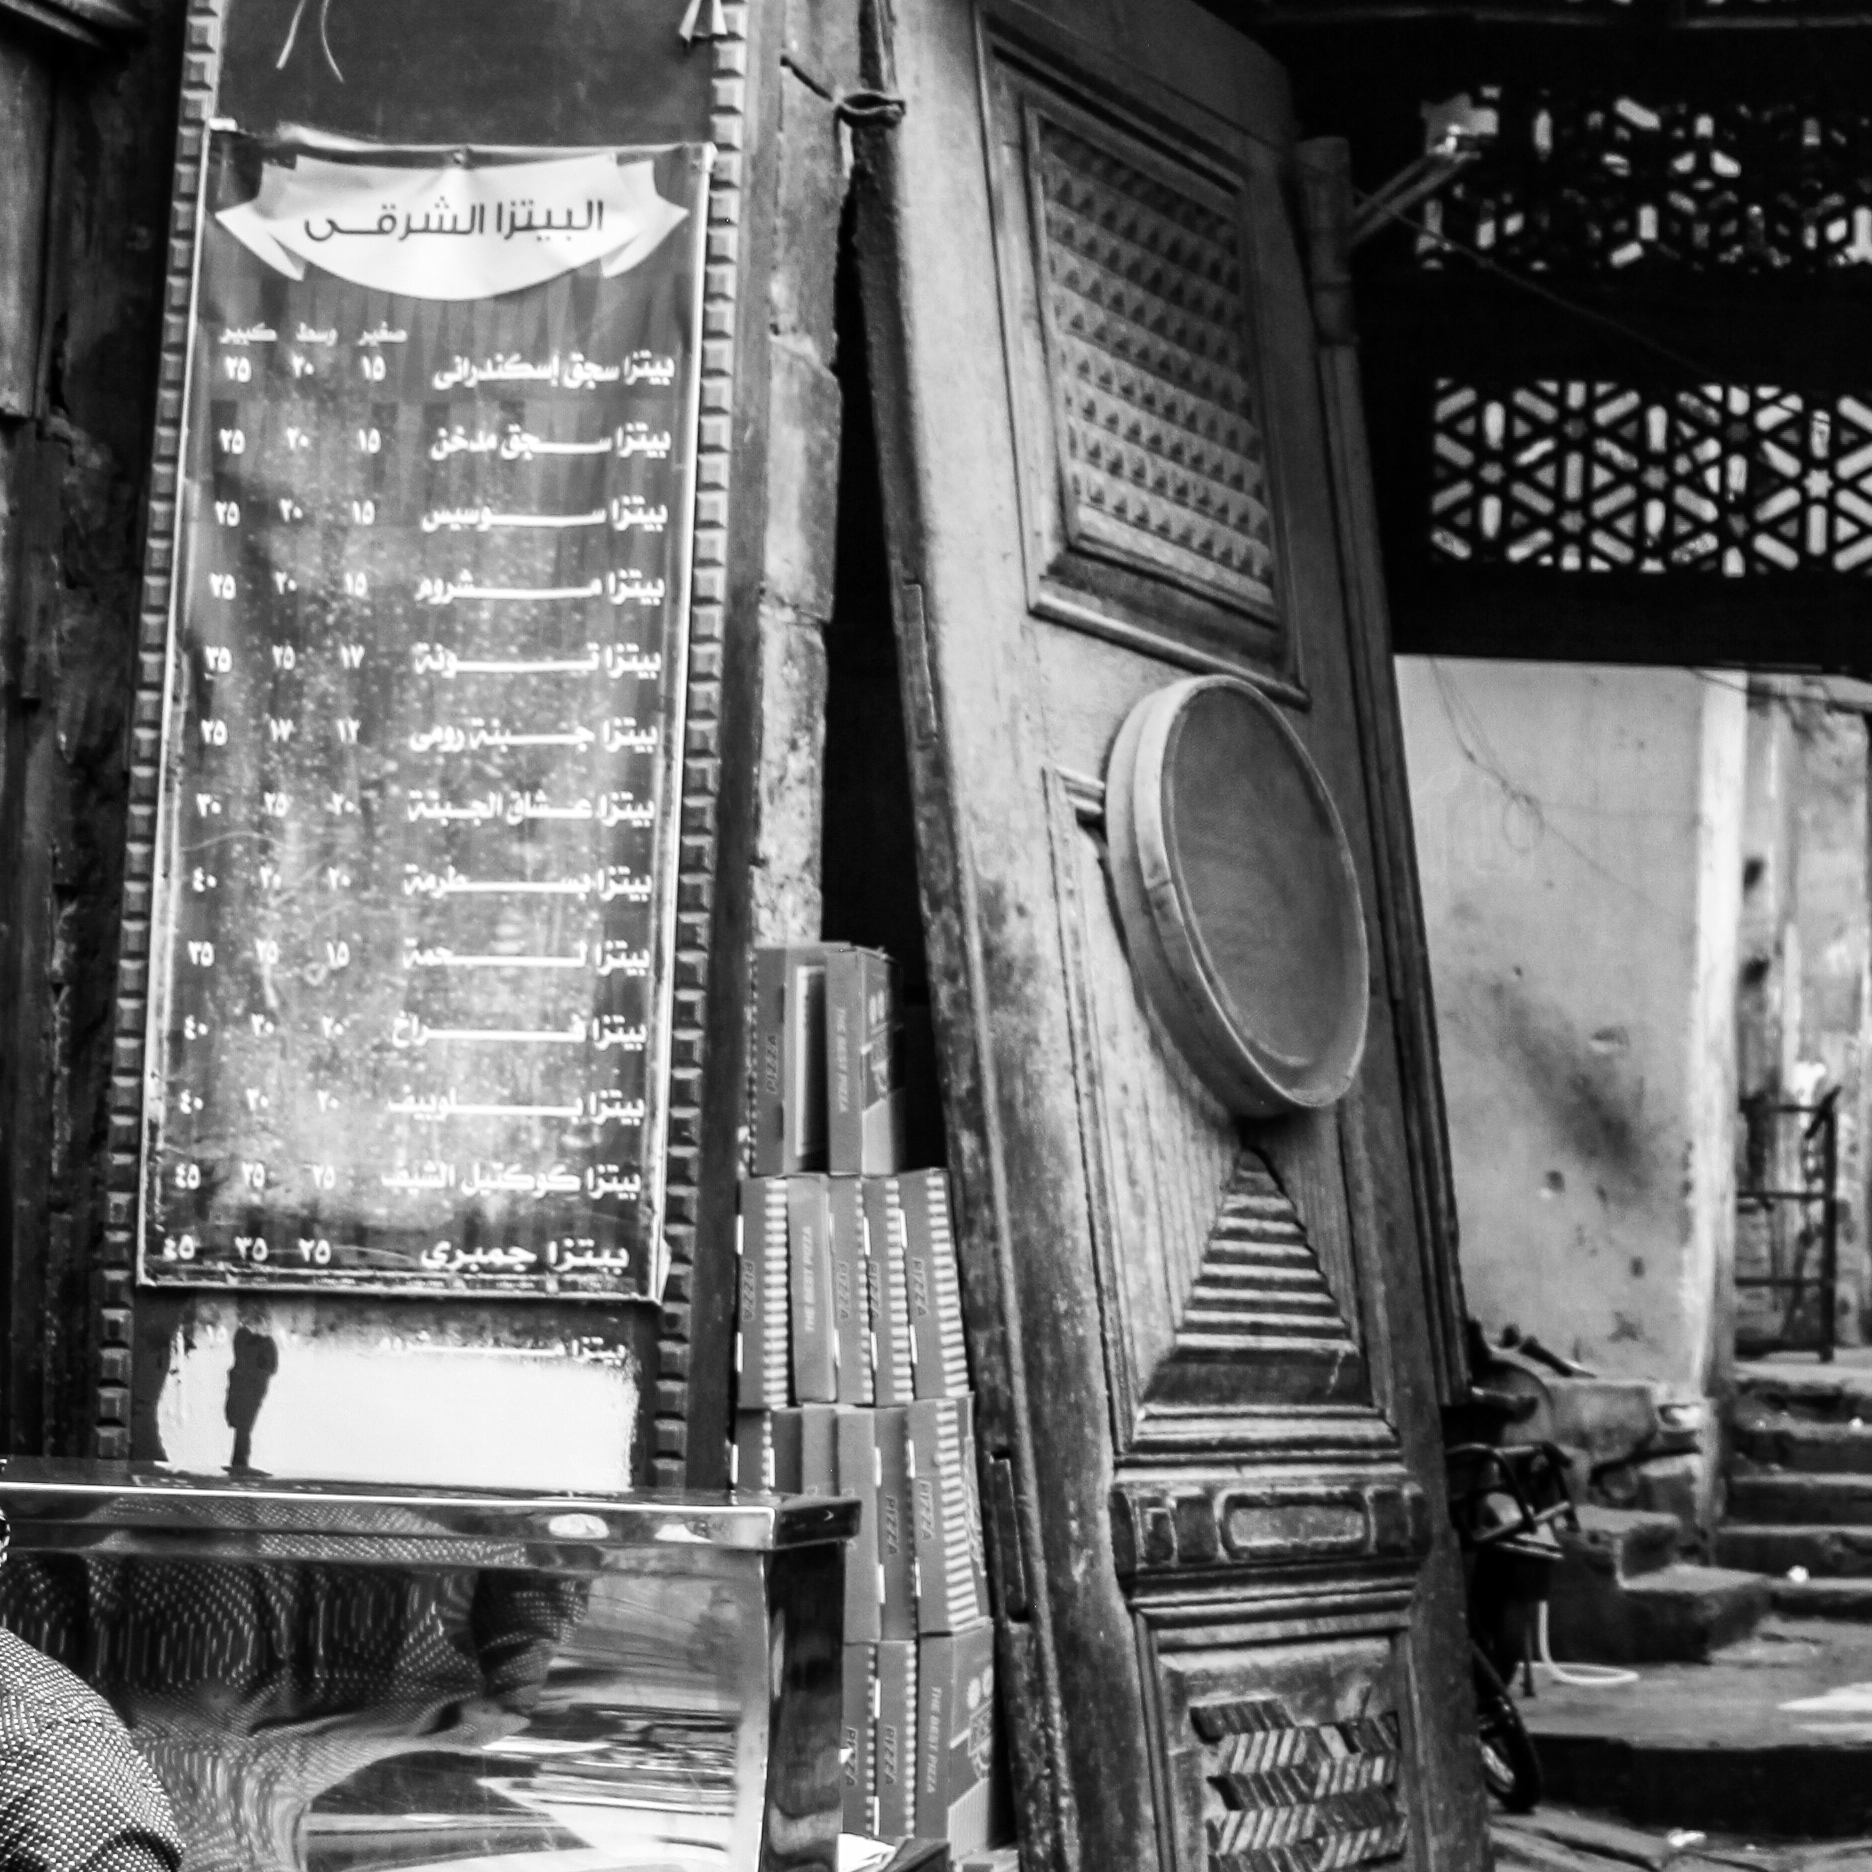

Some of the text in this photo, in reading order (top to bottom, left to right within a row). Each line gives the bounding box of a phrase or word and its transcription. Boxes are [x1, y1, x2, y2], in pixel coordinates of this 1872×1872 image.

[496, 199, 604, 241] البيتزا
[219, 322, 277, 347] كبير
[361, 354, 386, 381] ١٥
[562, 351, 620, 389] سجق
[623, 349, 675, 386] بيتزا
[358, 428, 382, 455] ١٥
[429, 424, 498, 462] مدخن
[500, 423, 613, 461] سجق
[615, 421, 671, 458] بيتزا
[352, 499, 376, 526] ١٥
[611, 495, 667, 532] بيتزا
[344, 571, 368, 598] ١٥
[414, 569, 602, 605] مشروم
[608, 569, 665, 605] بيتزا
[340, 643, 366, 670] ١٧
[412, 642, 600, 679] تونة
[605, 642, 661, 679] بيتزا
[602, 717, 658, 754] بيتزا
[600, 792, 655, 827] بيتزا
[597, 866, 652, 901] بيتزا
[595, 940, 650, 976] بيتزا
[592, 1015, 646, 1051] بيتزا
[764, 1035, 779, 1094] PIZZA
[589, 1088, 645, 1126] بيتزا
[583, 1164, 641, 1200] بيتزا
[546, 1236, 630, 1276] بيتزا
[741, 1260, 755, 1322] PIZZA
[836, 1260, 851, 1321] PIZZA
[911, 1256, 930, 1318] PIZZA
[885, 1494, 901, 1556] PIZZA
[917, 1479, 936, 1542] PIZZA
[884, 1724, 898, 1785] PIZZA
[926, 1686, 943, 1794] THE BEST PIZZA
